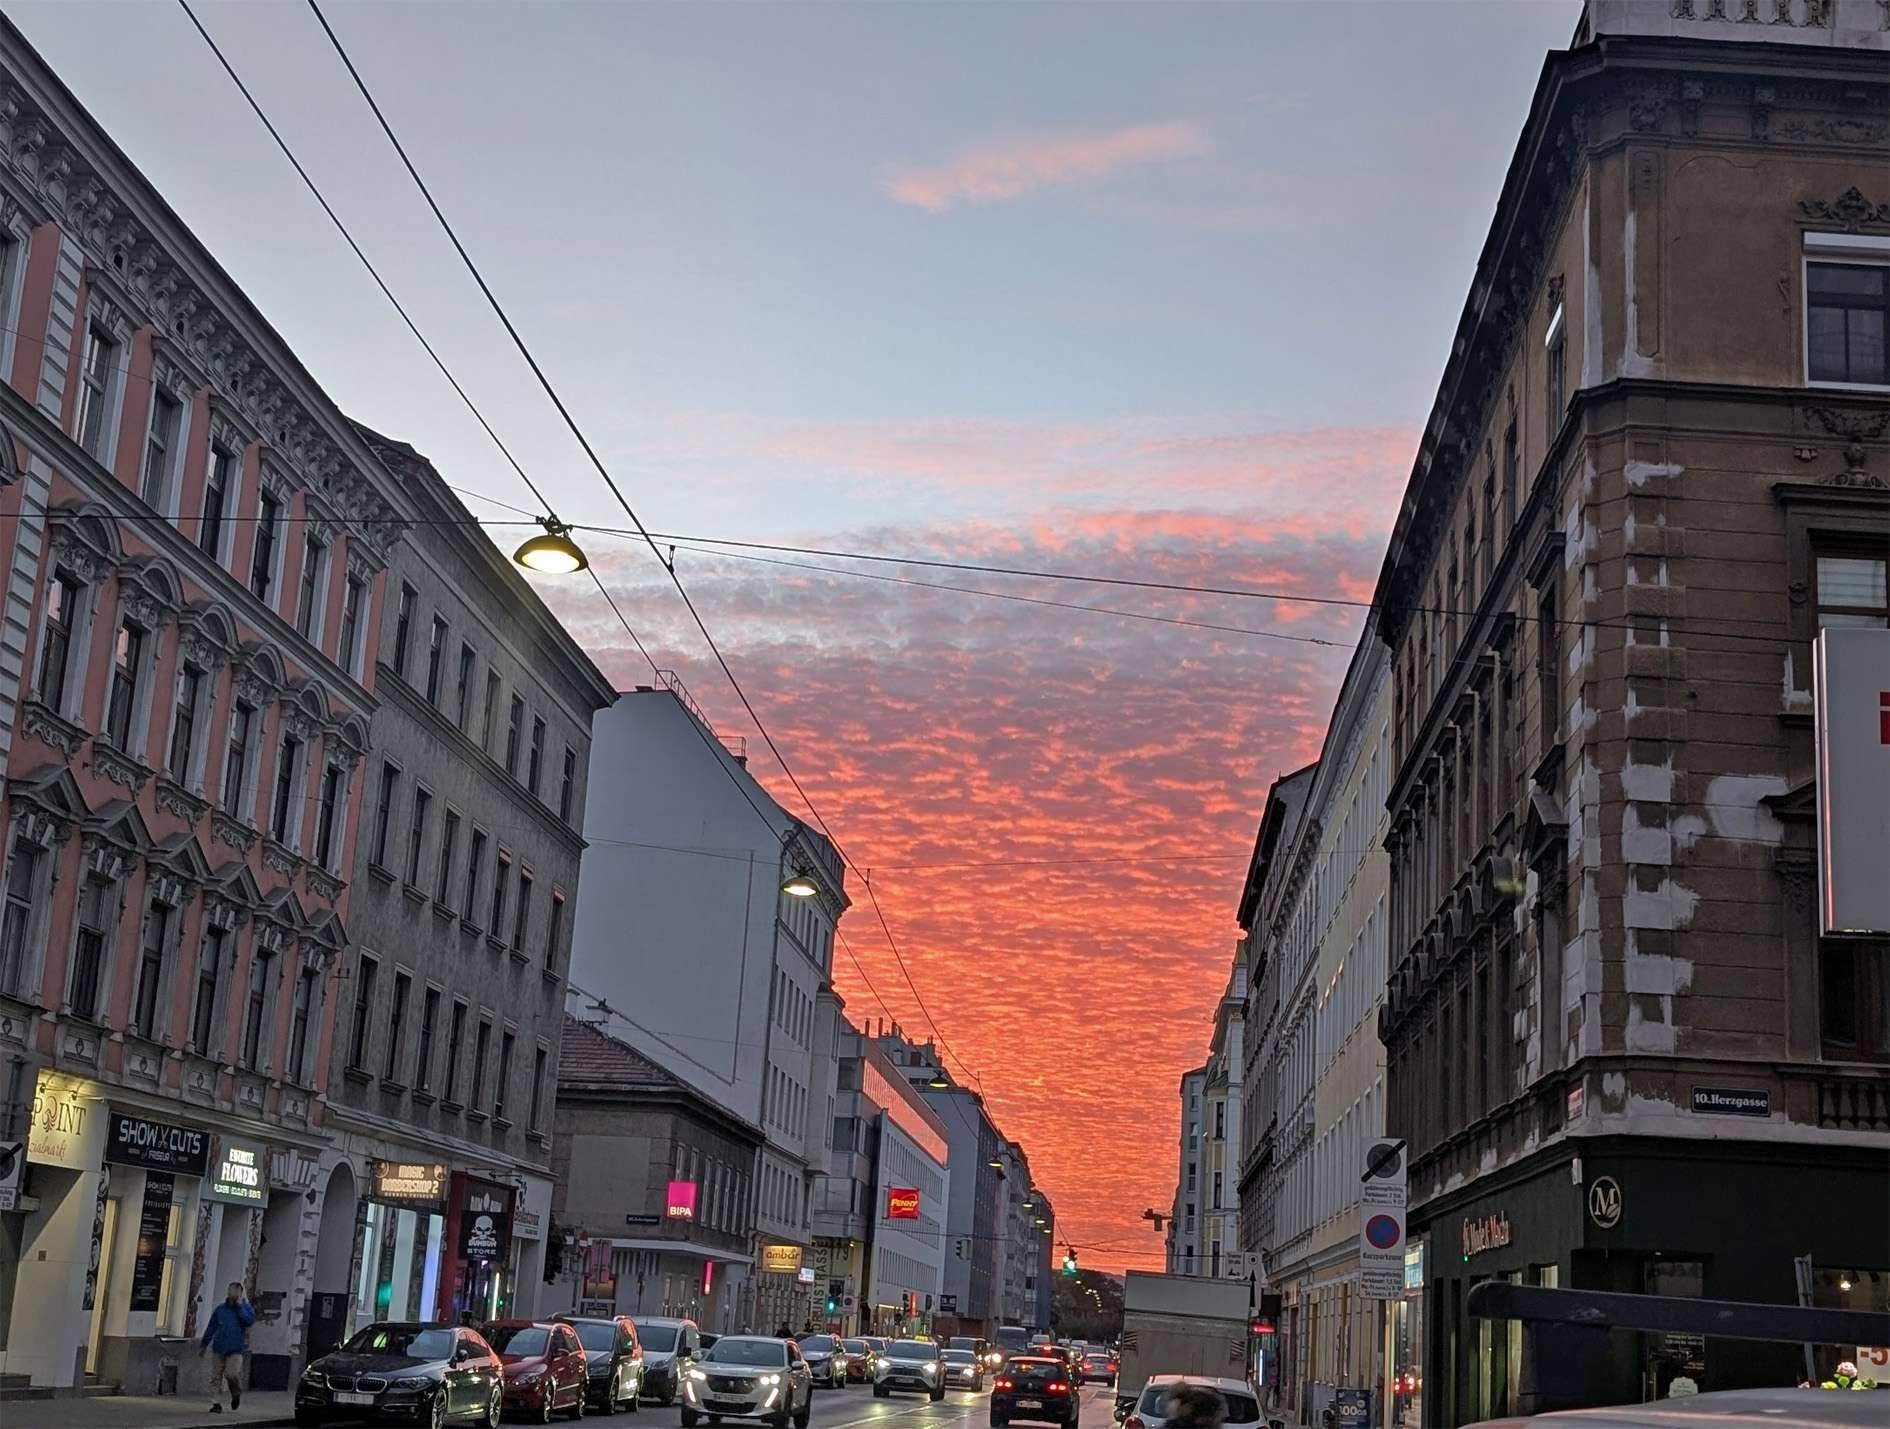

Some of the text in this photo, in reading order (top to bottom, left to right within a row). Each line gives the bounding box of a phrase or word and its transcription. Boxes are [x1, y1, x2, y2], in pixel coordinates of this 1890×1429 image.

[118, 1119, 202, 1154] SHOW CUTS
[221, 1162, 259, 1186] FLOWERS
[398, 1165, 425, 1179] MAGIC
[432, 1180, 439, 1194] 2
[891, 1198, 918, 1208] PENNY
[669, 1206, 692, 1217] BIPA
[467, 1248, 497, 1256] STORE
